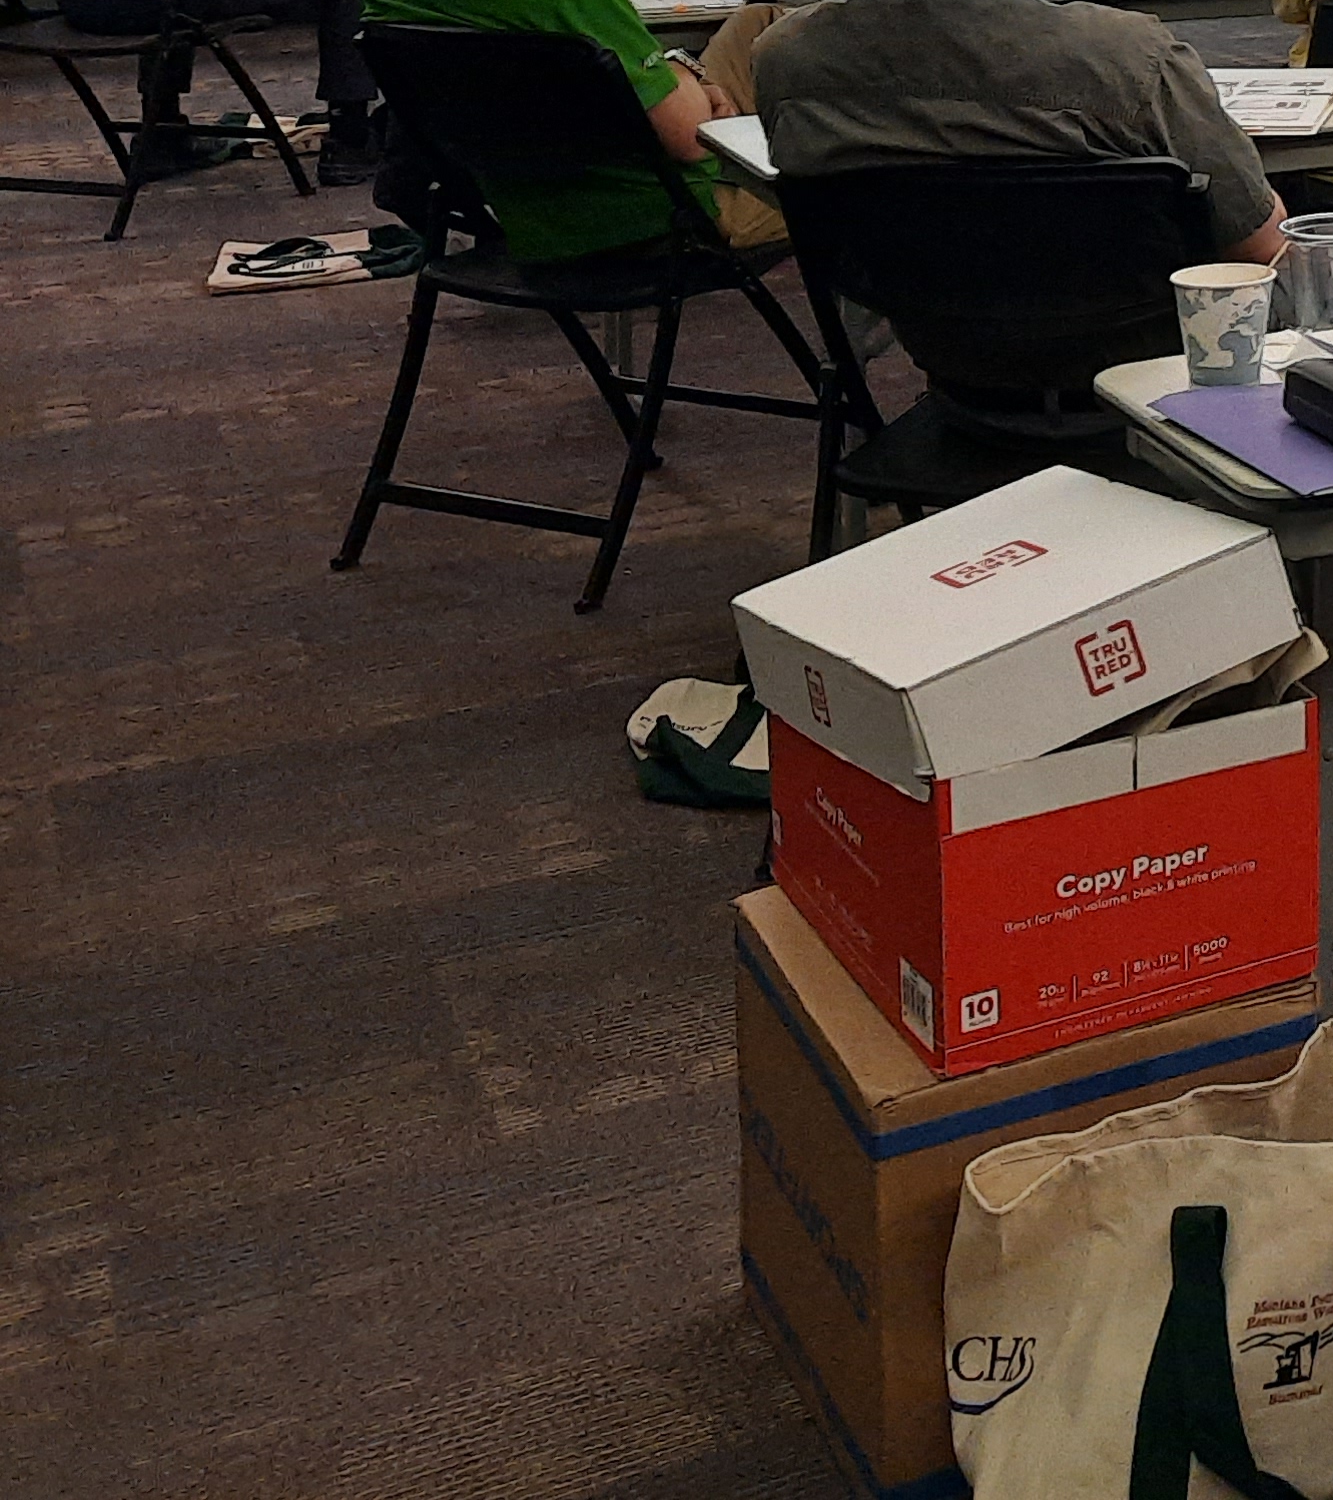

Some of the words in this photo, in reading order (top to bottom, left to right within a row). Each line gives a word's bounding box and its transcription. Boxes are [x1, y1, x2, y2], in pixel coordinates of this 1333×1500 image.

[1088, 635, 1128, 662] TRU
[1093, 654, 1134, 680] RED
[1056, 867, 1127, 899] Copy
[1132, 845, 1209, 879] Paper
[1004, 918, 1033, 934] Best
[1034, 913, 1053, 927] for
[1133, 881, 1164, 900] black
[1177, 871, 1209, 888] white
[1211, 860, 1257, 880] printing
[1193, 936, 1229, 956] 5000
[1092, 970, 1110, 984] 92
[965, 996, 994, 1019] 10
[951, 1336, 1037, 1382] CHS
